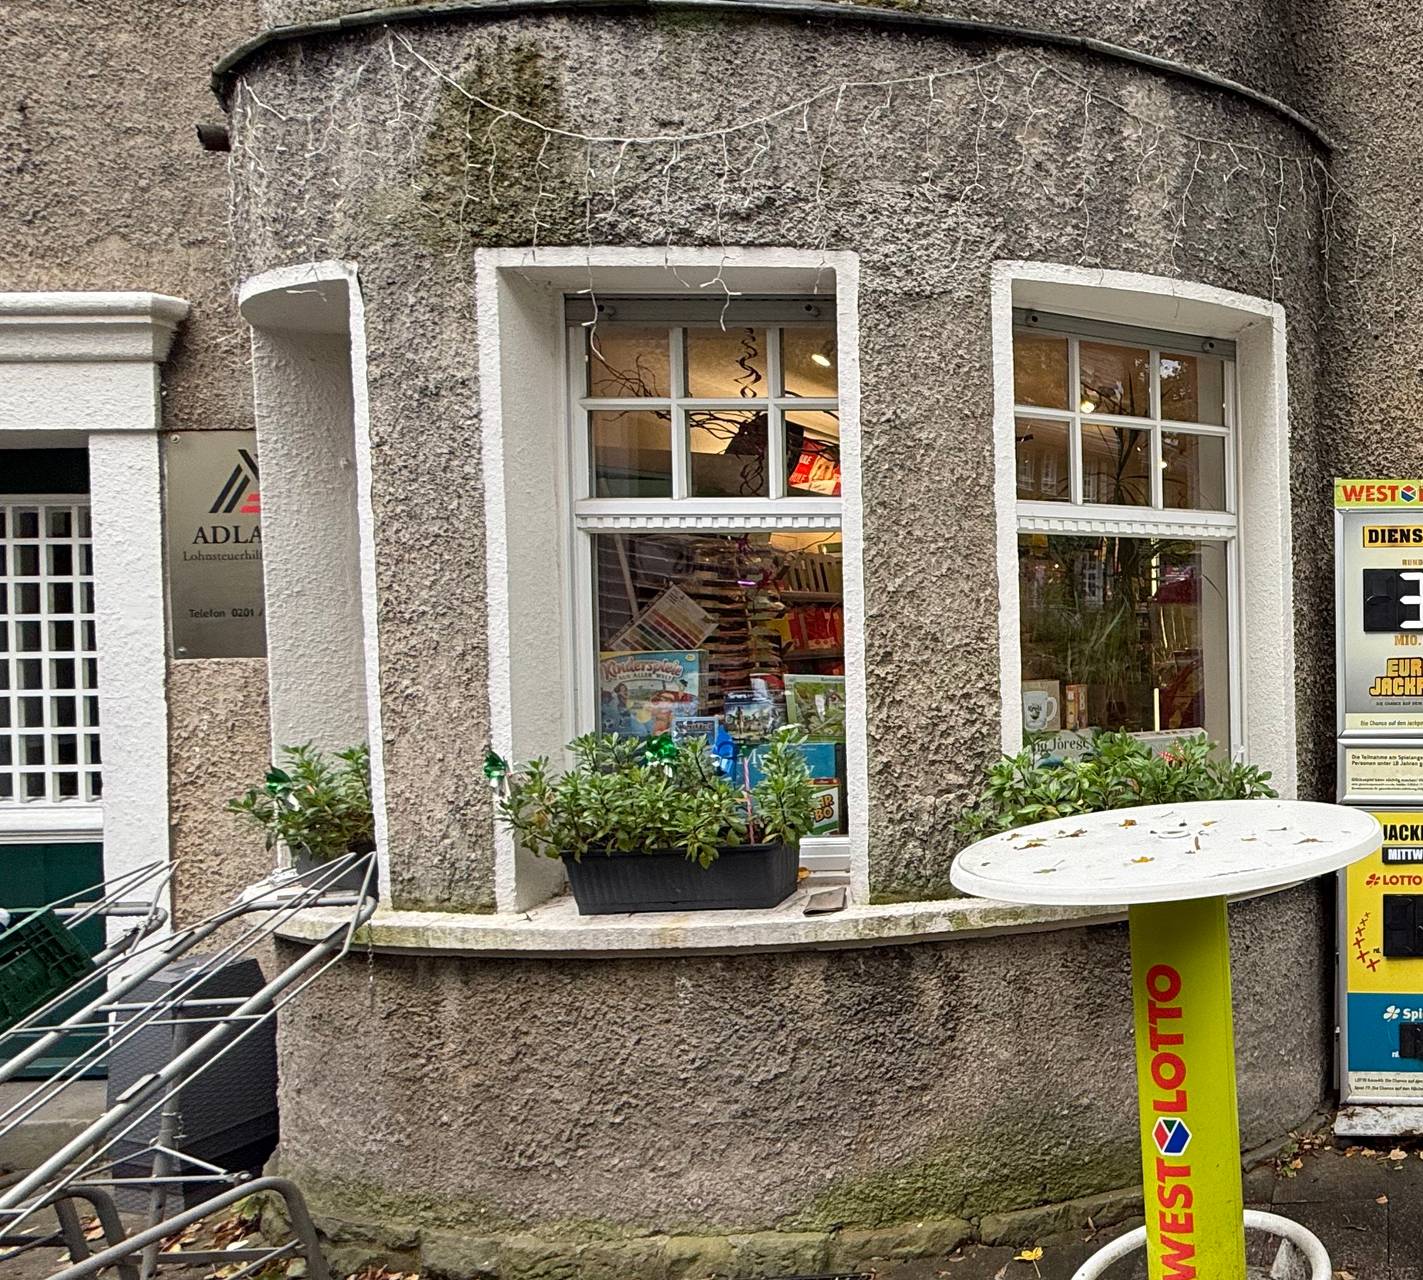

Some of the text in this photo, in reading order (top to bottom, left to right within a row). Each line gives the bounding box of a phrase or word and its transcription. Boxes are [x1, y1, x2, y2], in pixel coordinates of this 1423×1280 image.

[1342, 484, 1399, 503] WEST
[189, 608, 225, 618] Telefon
[231, 608, 254, 617] 0201
[1382, 875, 1423, 886] LOTTO
[1146, 963, 1189, 1114] LOTTO
[1156, 1156, 1198, 1280] WEST
